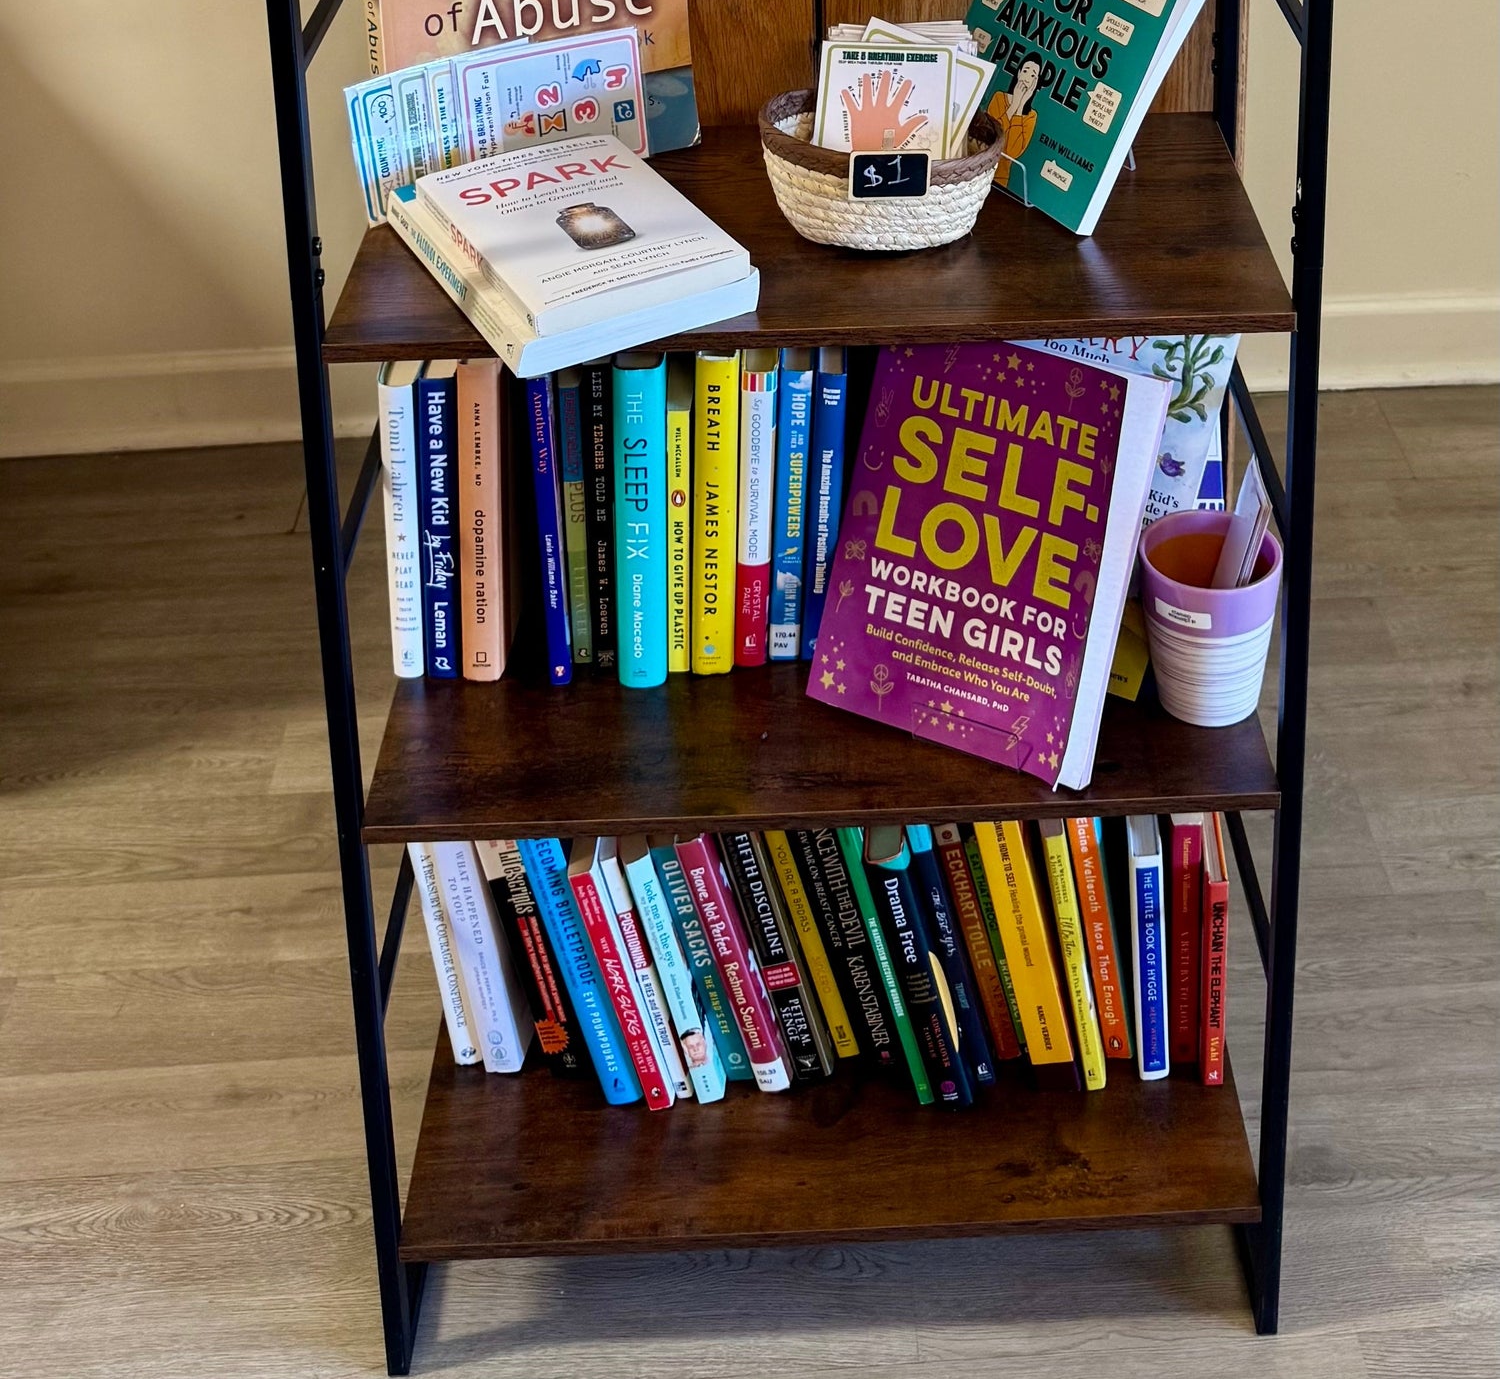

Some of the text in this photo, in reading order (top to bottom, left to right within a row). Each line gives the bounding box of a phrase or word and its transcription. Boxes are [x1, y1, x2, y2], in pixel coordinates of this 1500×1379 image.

[424, 4, 464, 37] of
[460, 155, 631, 206] SPARK
[1039, 134, 1094, 173] ERIN WILLIAMS
[627, 392, 643, 424] THE
[911, 375, 1099, 460] ULTIMATE
[624, 438, 648, 512] SLEEP
[704, 384, 720, 615] BREATH JAMES NESTOR
[427, 391, 449, 648] Have New Kid Leman
[874, 486, 1078, 609] LOVE
[474, 510, 485, 624] dopamine nation
[632, 574, 643, 607] Diane
[674, 521, 684, 650] HOW TO GIVE UP PLASTIC
[870, 557, 1066, 640] WORKBOOK FOR
[633, 613, 644, 658] Macedo
[864, 586, 1061, 676] TEEN GIRLS
[662, 861, 711, 968] OLIVER SACKS
[702, 901, 720, 924] Not
[735, 834, 757, 878] FIFTH
[750, 880, 784, 955] DISCIPLINE
[1083, 857, 1098, 912] Welteroth
[709, 922, 732, 956] Perfect
[884, 877, 917, 964] Drama Free
[1092, 923, 1104, 950] More
[1143, 872, 1157, 1002] THE LITTLE BOOK OF HYGGE
[724, 962, 747, 1005] Reshma
[1097, 955, 1109, 981] Than
[1209, 902, 1224, 1061] UNCHAIN THE ELEPHANT Wahl
[740, 1006, 761, 1049] Saujani
[1103, 986, 1116, 1025] Enough
